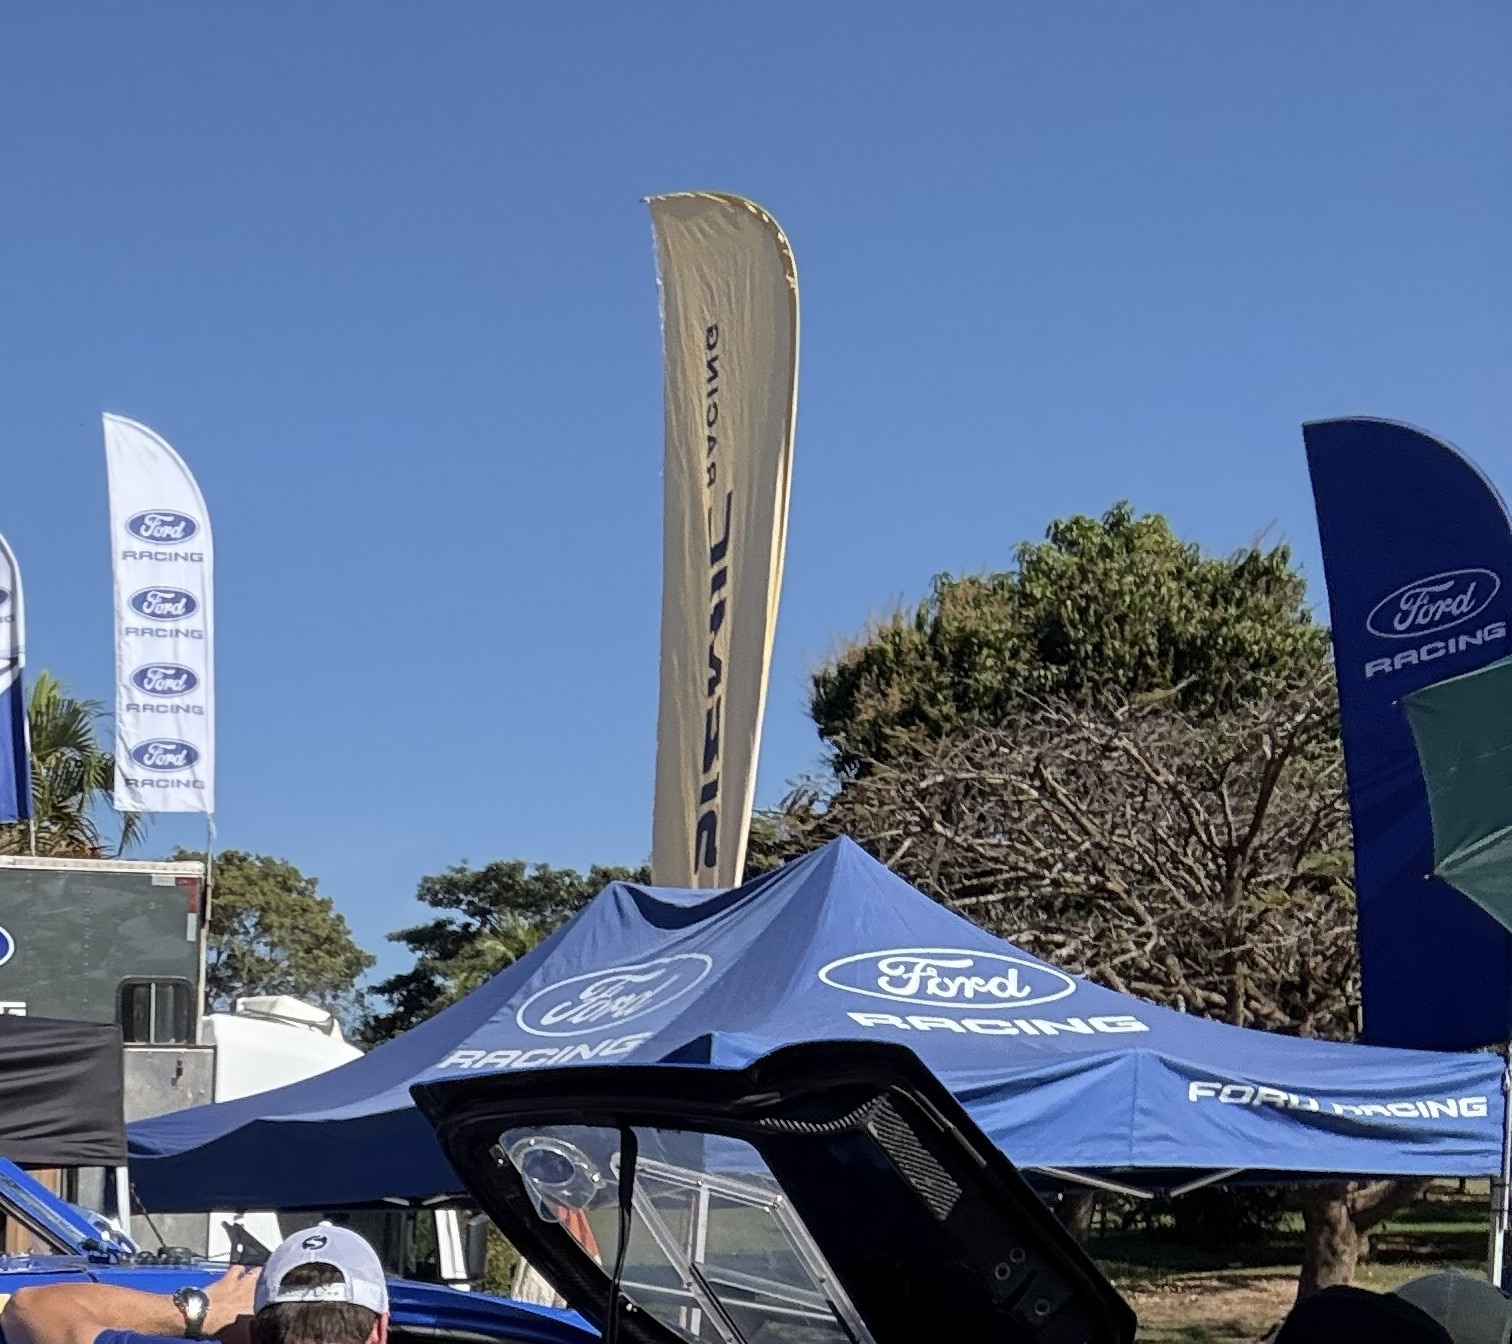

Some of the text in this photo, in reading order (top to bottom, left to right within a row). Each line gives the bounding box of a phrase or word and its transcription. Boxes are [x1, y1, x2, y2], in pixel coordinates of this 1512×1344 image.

[140, 514, 187, 539] Ford
[122, 550, 204, 562] RACING
[142, 591, 188, 615] Ford
[1393, 580, 1477, 631] Ford
[125, 627, 203, 639] RACING
[1364, 621, 1506, 678] RACING
[143, 667, 188, 691] Ford
[125, 704, 204, 715] RACING
[143, 743, 188, 766] Ford
[125, 779, 205, 790] RACING
[877, 956, 1033, 1000] Ford
[540, 966, 680, 1025] Ford
[846, 1010, 1152, 1035] RACING
[438, 1031, 653, 1068] RACING
